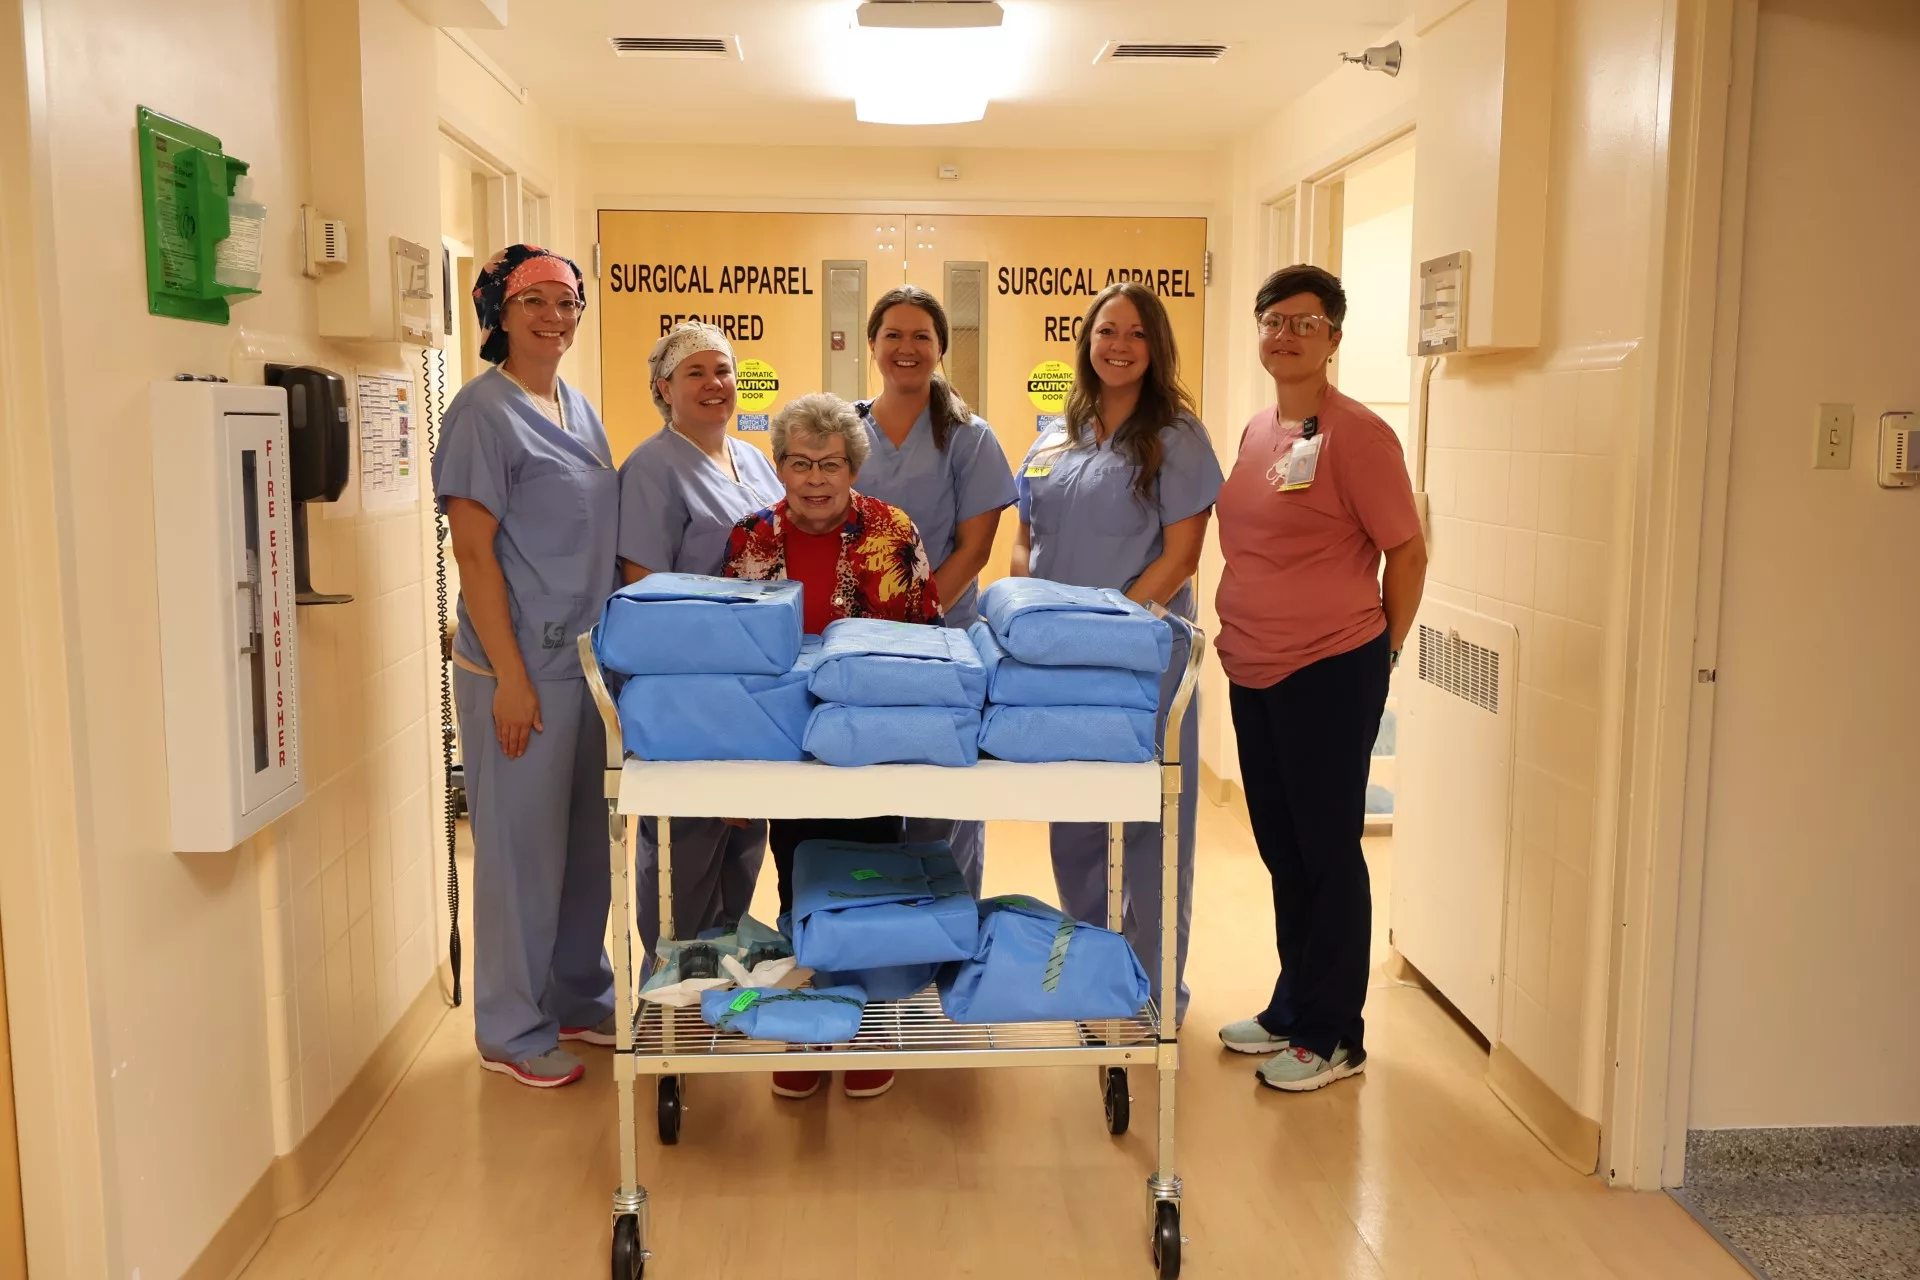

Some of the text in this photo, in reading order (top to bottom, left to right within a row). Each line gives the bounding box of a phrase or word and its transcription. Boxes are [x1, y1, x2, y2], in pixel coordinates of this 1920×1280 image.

[610, 263, 814, 295] SURGICAL APPAREL
[998, 266, 1098, 296] SURGICAL
[660, 314, 764, 341] RIRED
[737, 380, 776, 390] AUTION
[265, 439, 286, 769] FIRE EXTINGUISHER
